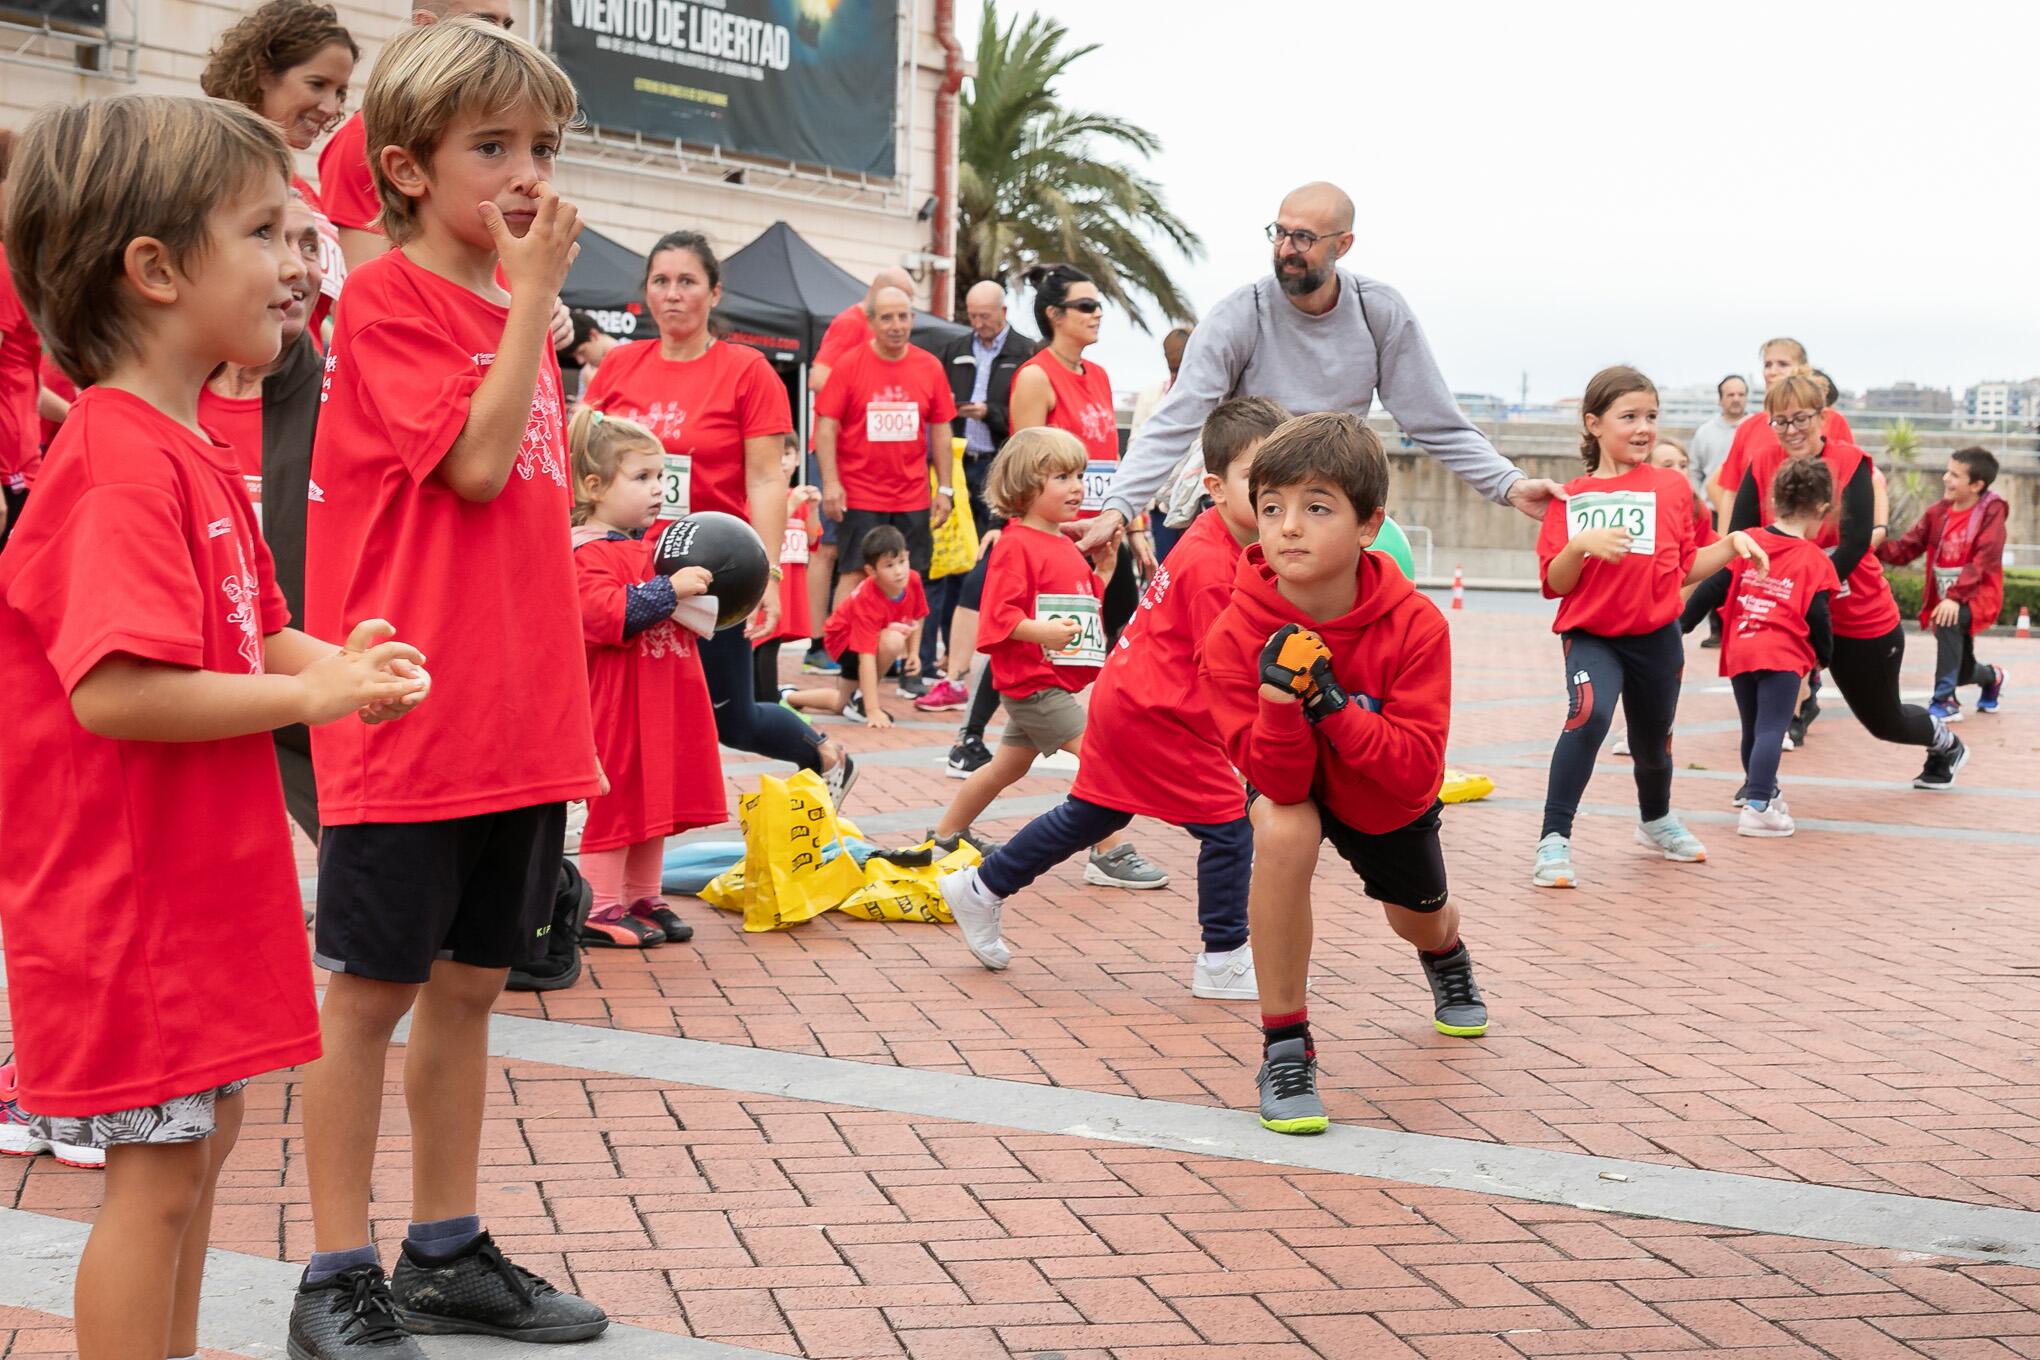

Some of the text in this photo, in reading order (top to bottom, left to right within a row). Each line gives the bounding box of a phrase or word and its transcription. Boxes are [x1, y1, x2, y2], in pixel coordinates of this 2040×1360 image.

[569, 0, 653, 41] VIENTO
[656, 0, 687, 49] DE
[689, 5, 791, 71] LIBERTAD
[873, 413, 914, 432] 3004
